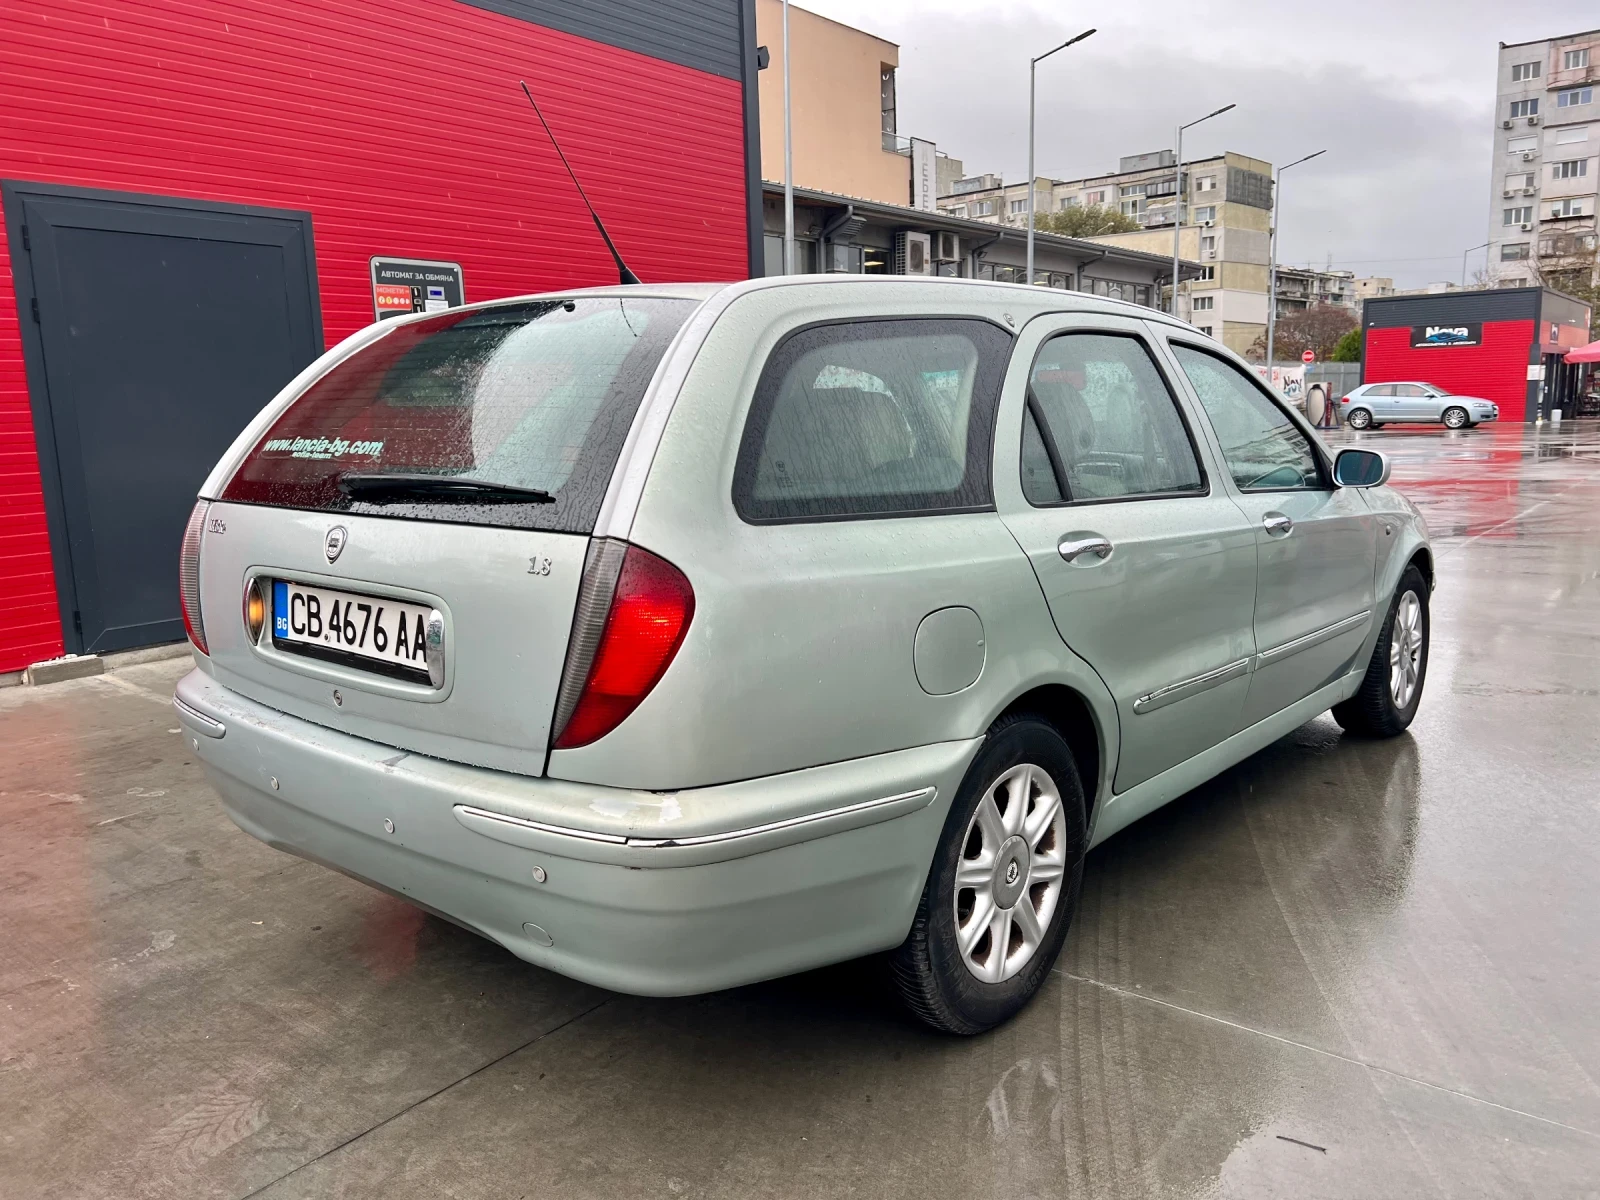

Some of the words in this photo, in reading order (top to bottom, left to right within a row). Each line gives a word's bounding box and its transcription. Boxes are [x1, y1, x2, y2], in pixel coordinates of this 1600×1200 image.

[381, 270, 413, 279] АВТОМАТ
[414, 272, 424, 280] ЗА
[425, 273, 454, 282] ОБМЯНА
[262, 436, 384, 456] www.lancia-bg.com
[276, 616, 288, 631] BG
